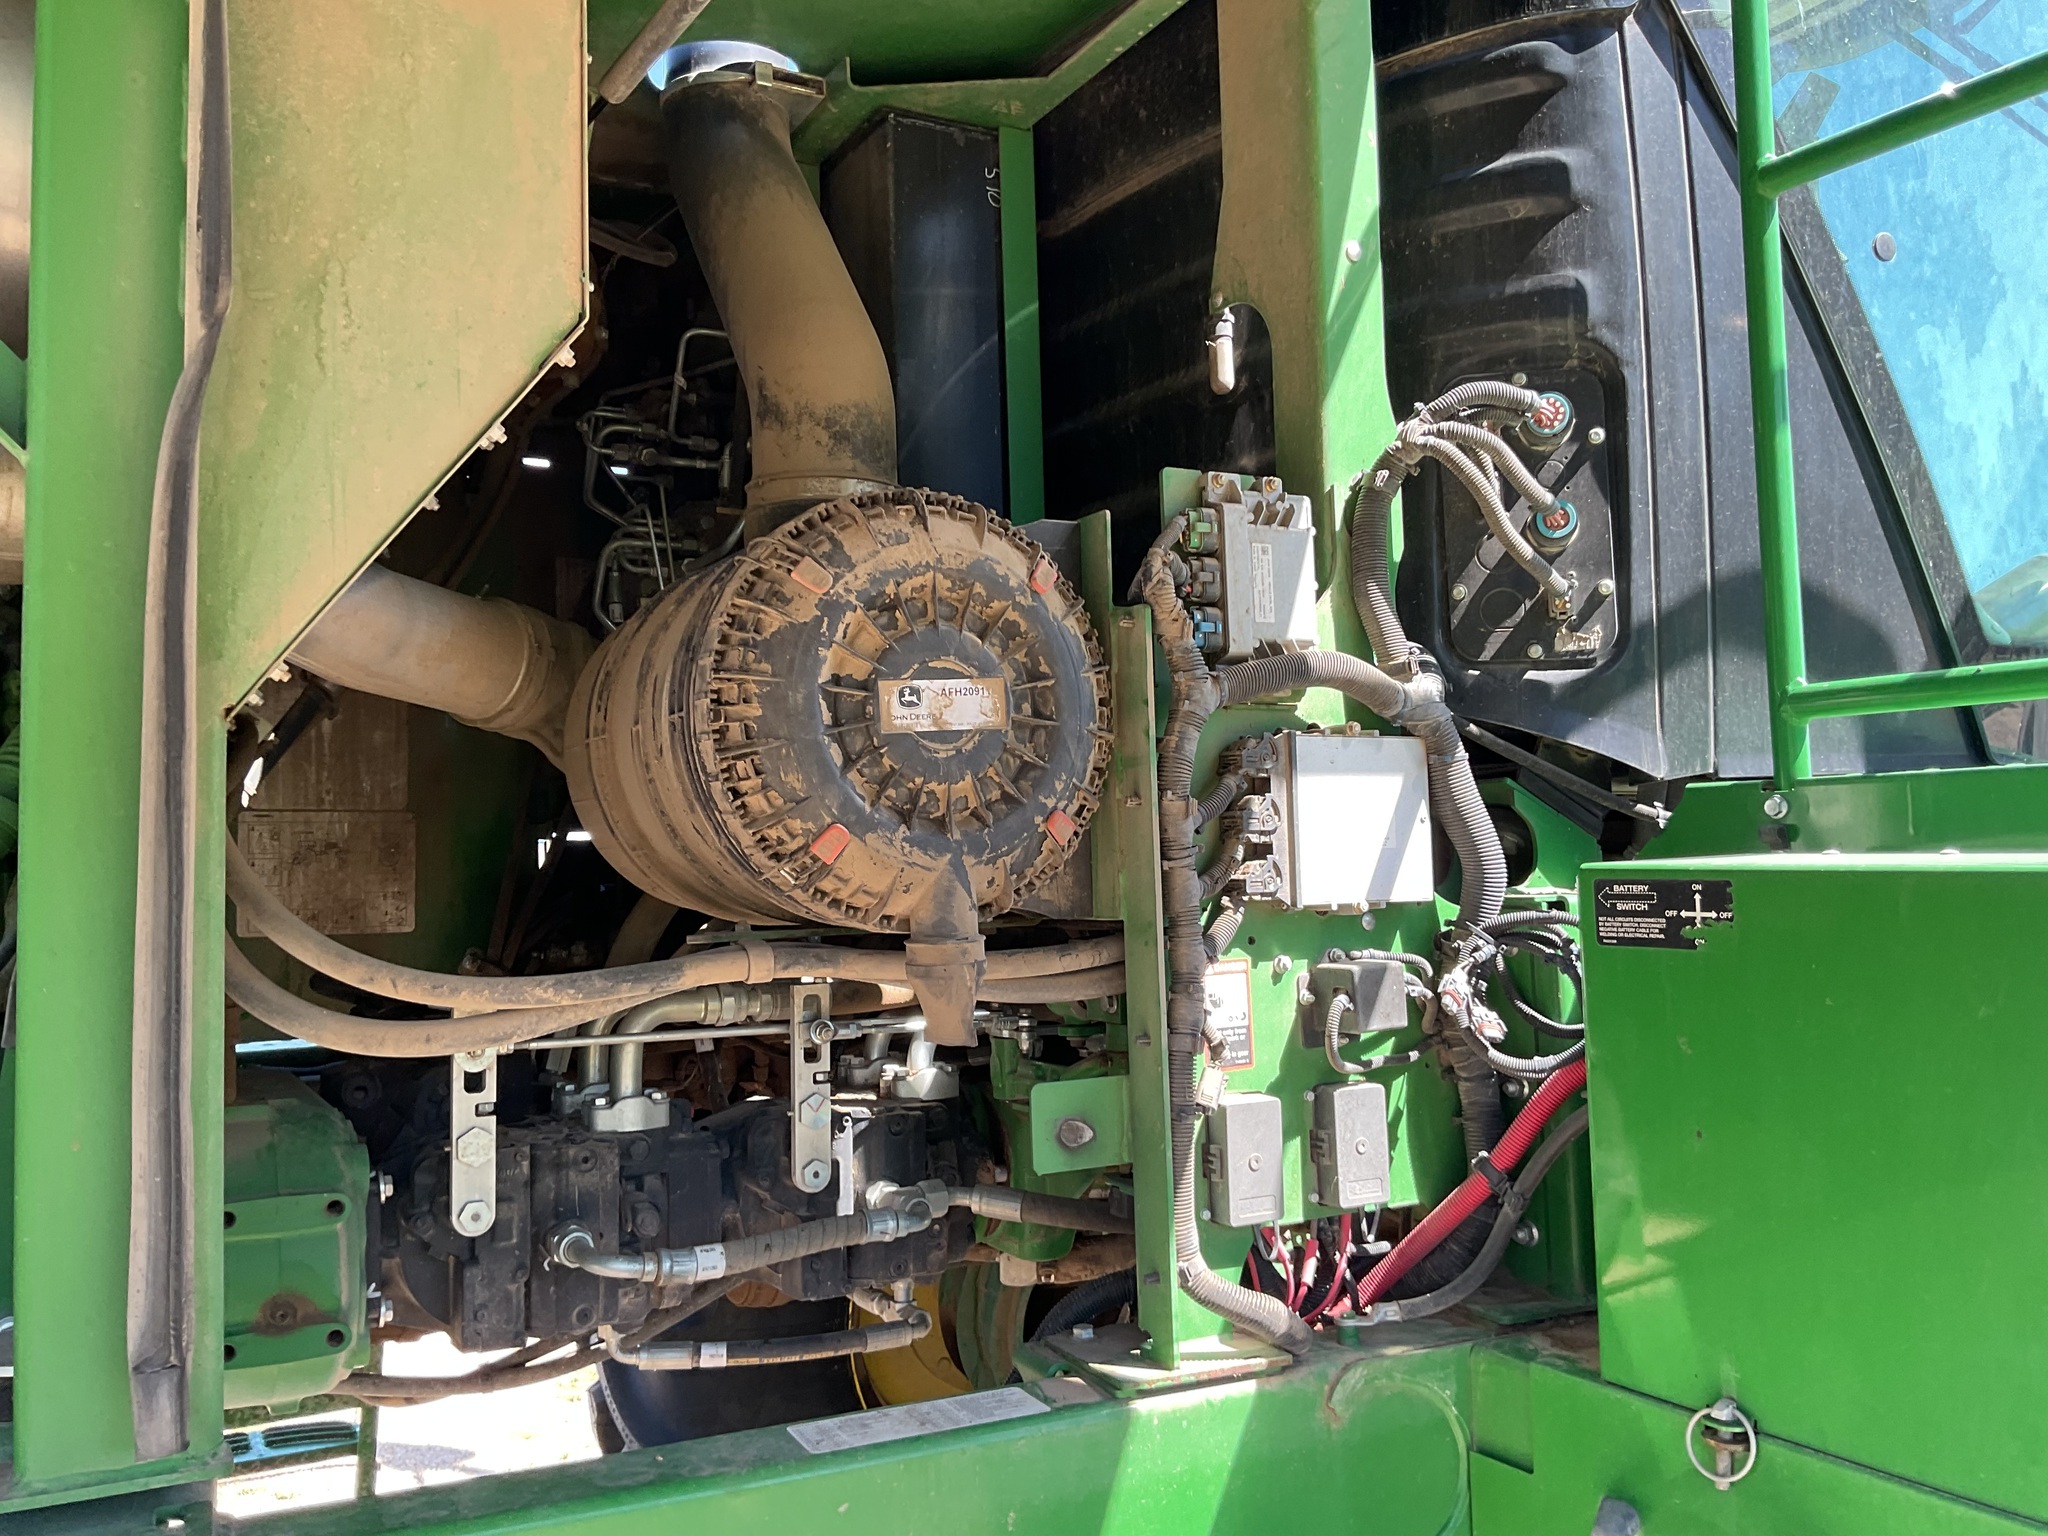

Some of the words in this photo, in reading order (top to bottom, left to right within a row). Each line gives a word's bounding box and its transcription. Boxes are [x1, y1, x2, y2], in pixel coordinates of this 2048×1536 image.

[1613, 884, 1649, 892] BATTERY
[1691, 883, 1702, 891] ON
[1616, 902, 1648, 911] SWITCH
[1664, 909, 1678, 917] OFF
[1719, 911, 1733, 919] OFF
